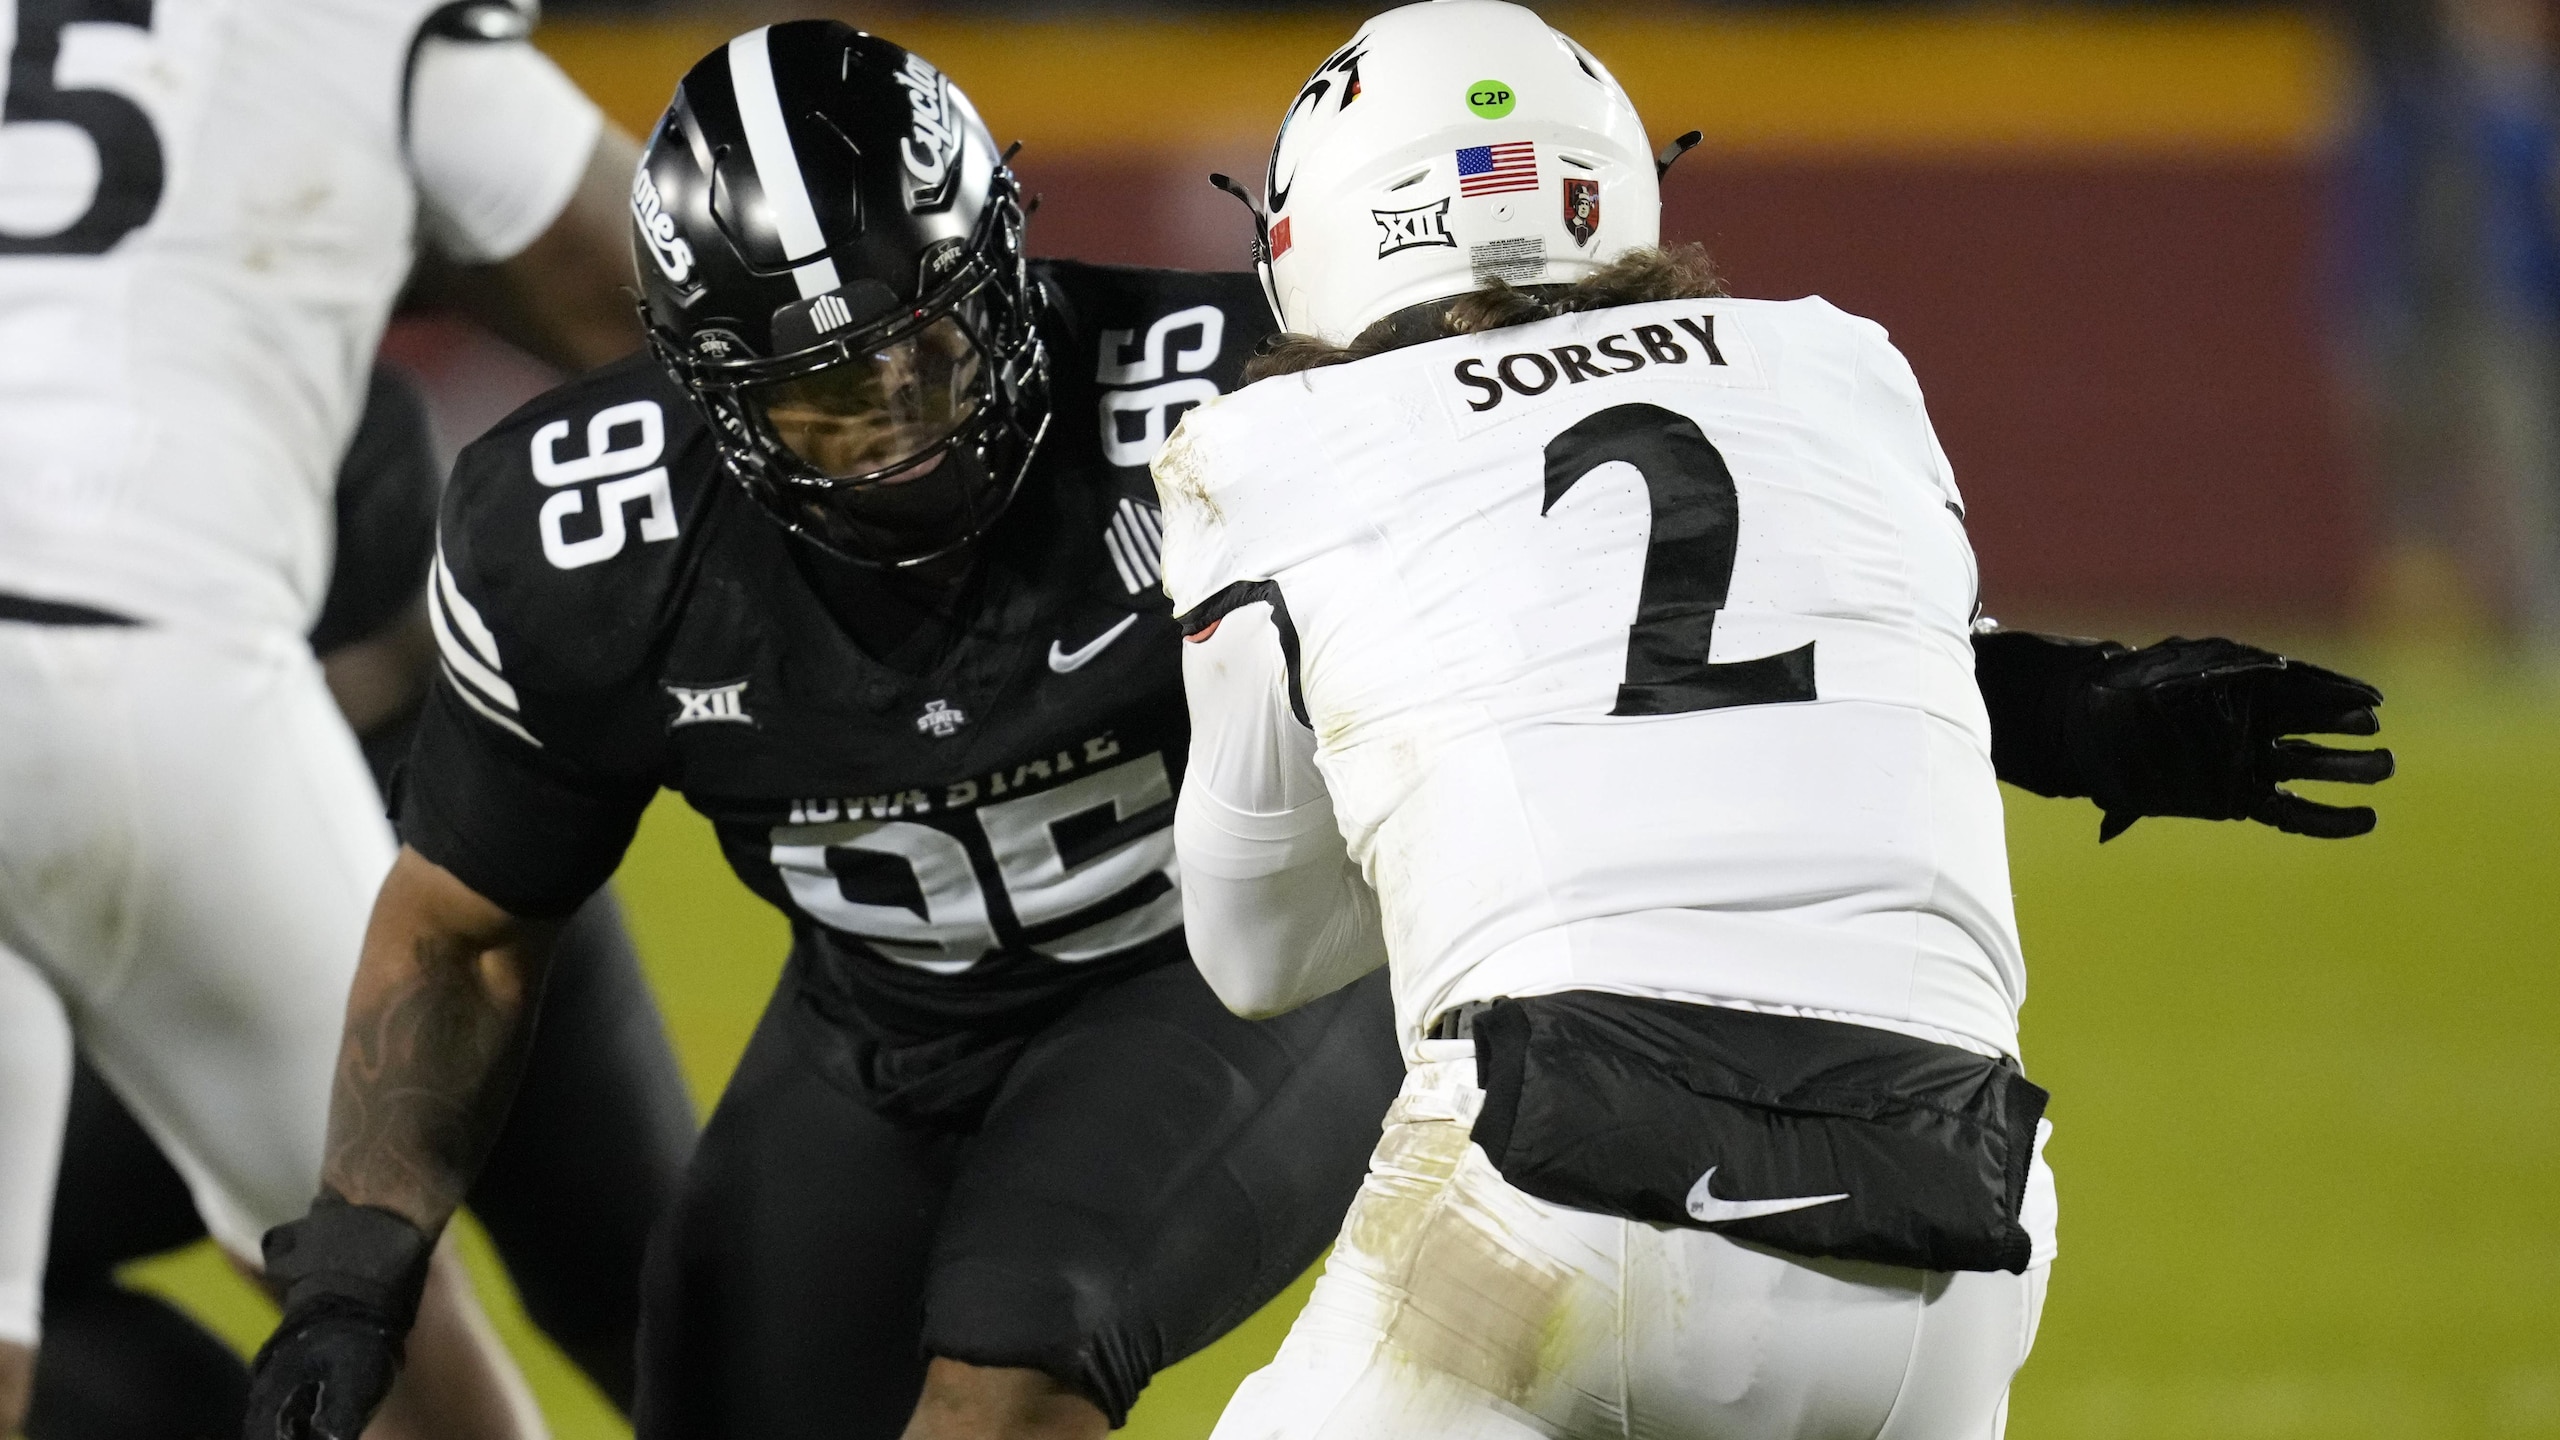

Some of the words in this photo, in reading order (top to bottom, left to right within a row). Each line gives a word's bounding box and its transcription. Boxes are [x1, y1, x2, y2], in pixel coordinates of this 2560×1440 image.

[1470, 91, 1510, 106] C2P
[1371, 196, 1458, 260] XII
[1096, 304, 1225, 467] 95
[1454, 315, 1728, 412] SORSBY
[530, 400, 680, 570] 95
[1541, 402, 1817, 716] 2
[665, 681, 753, 727] XII
[769, 750, 1183, 974] 95
